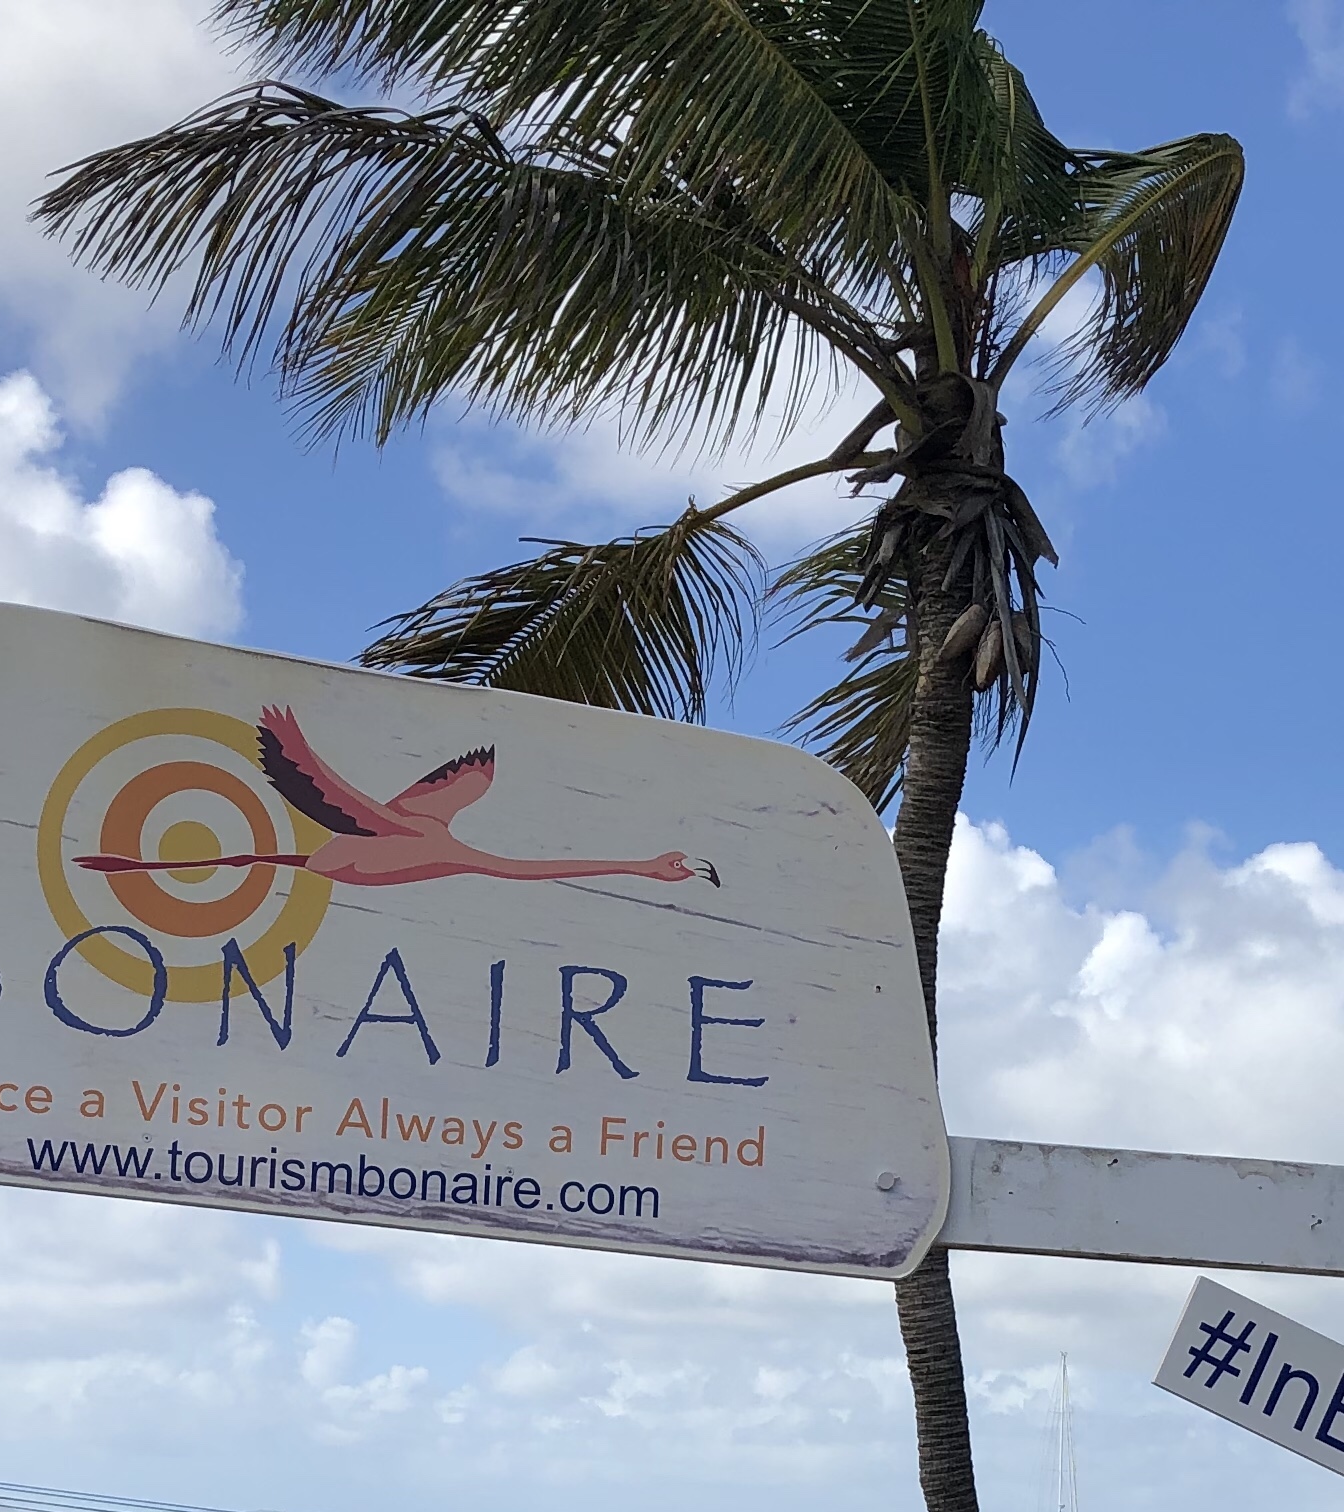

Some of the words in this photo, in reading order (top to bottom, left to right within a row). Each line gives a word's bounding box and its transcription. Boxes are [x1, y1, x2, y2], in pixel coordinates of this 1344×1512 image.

[79, 1087, 106, 1119] a
[131, 1079, 313, 1134] Visitor
[335, 1096, 525, 1160] Always
[548, 1124, 574, 1154] a
[599, 1115, 767, 1168] Friend
[26, 1137, 661, 1219] www.tourismbonaire.com
